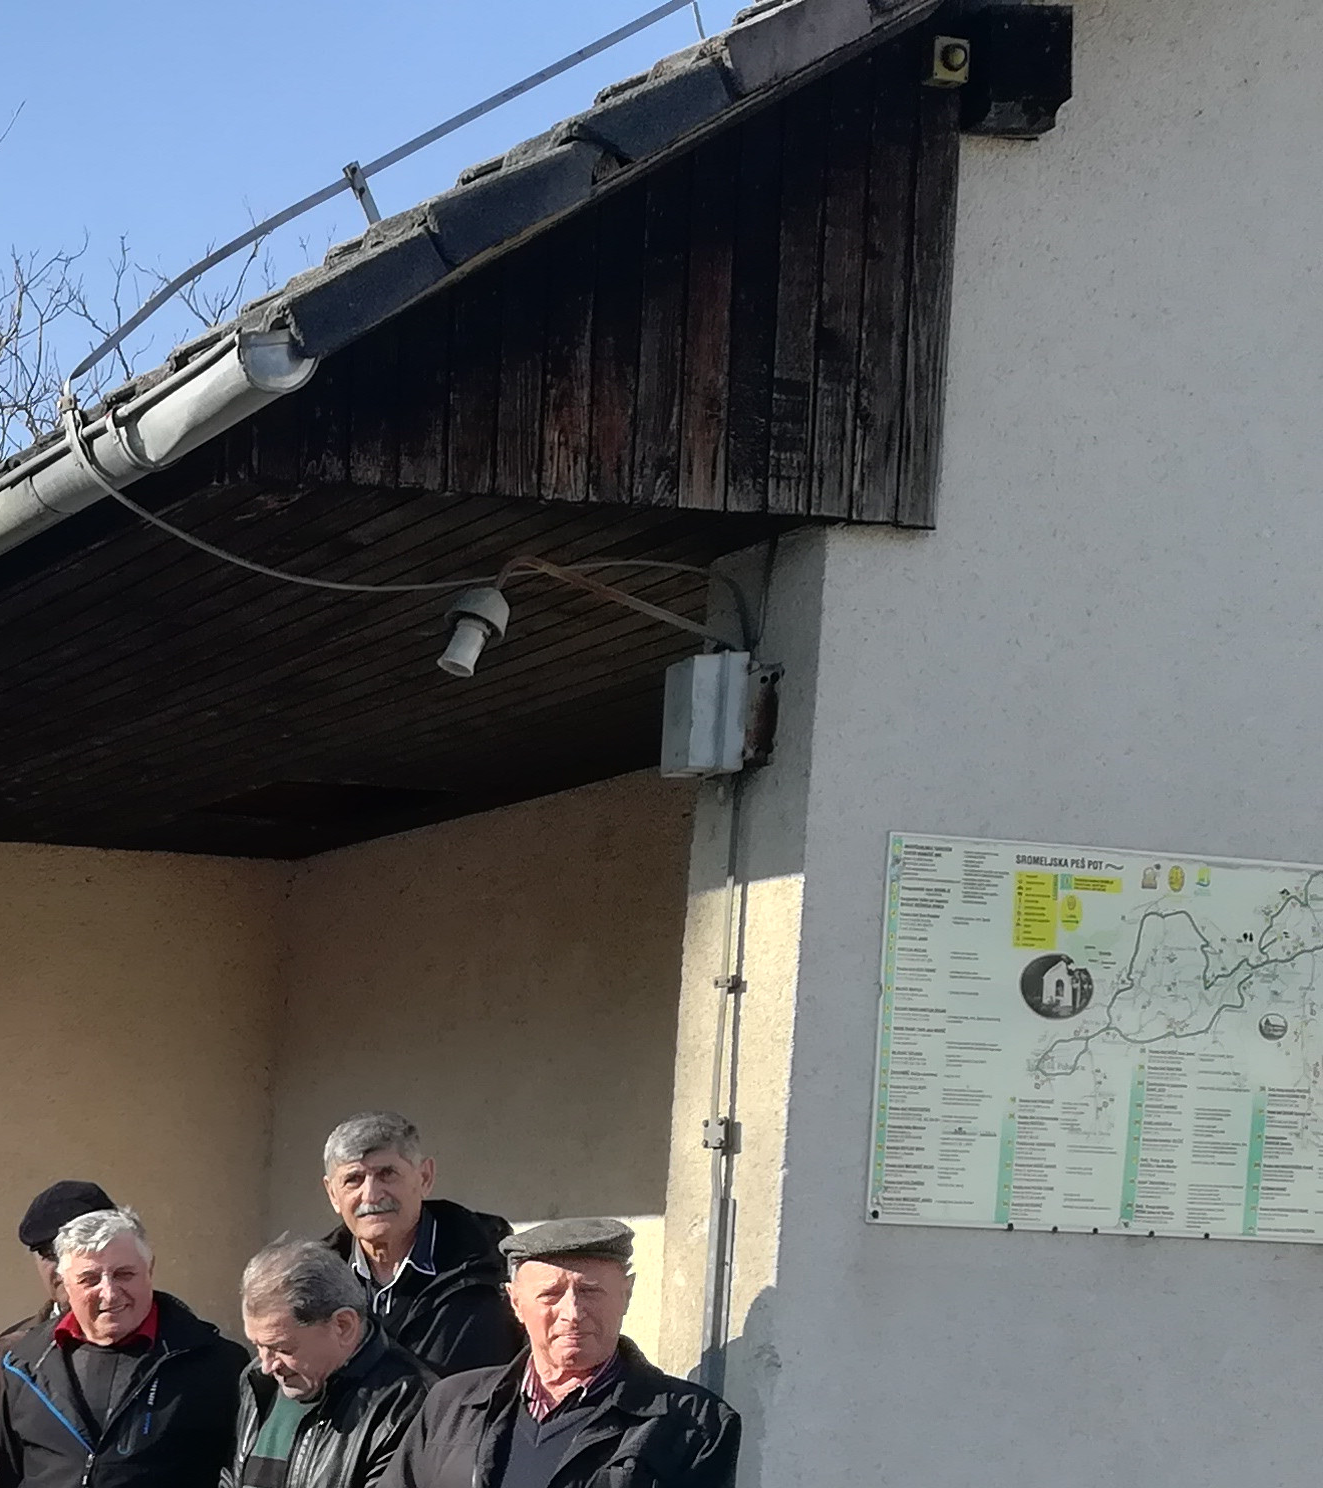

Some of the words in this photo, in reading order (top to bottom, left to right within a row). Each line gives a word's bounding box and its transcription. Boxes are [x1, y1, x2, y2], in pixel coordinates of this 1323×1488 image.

[1016, 854, 1068, 868] SROMELJSKA
[1070, 857, 1086, 870] PEŠ
[1087, 860, 1104, 870] POT
